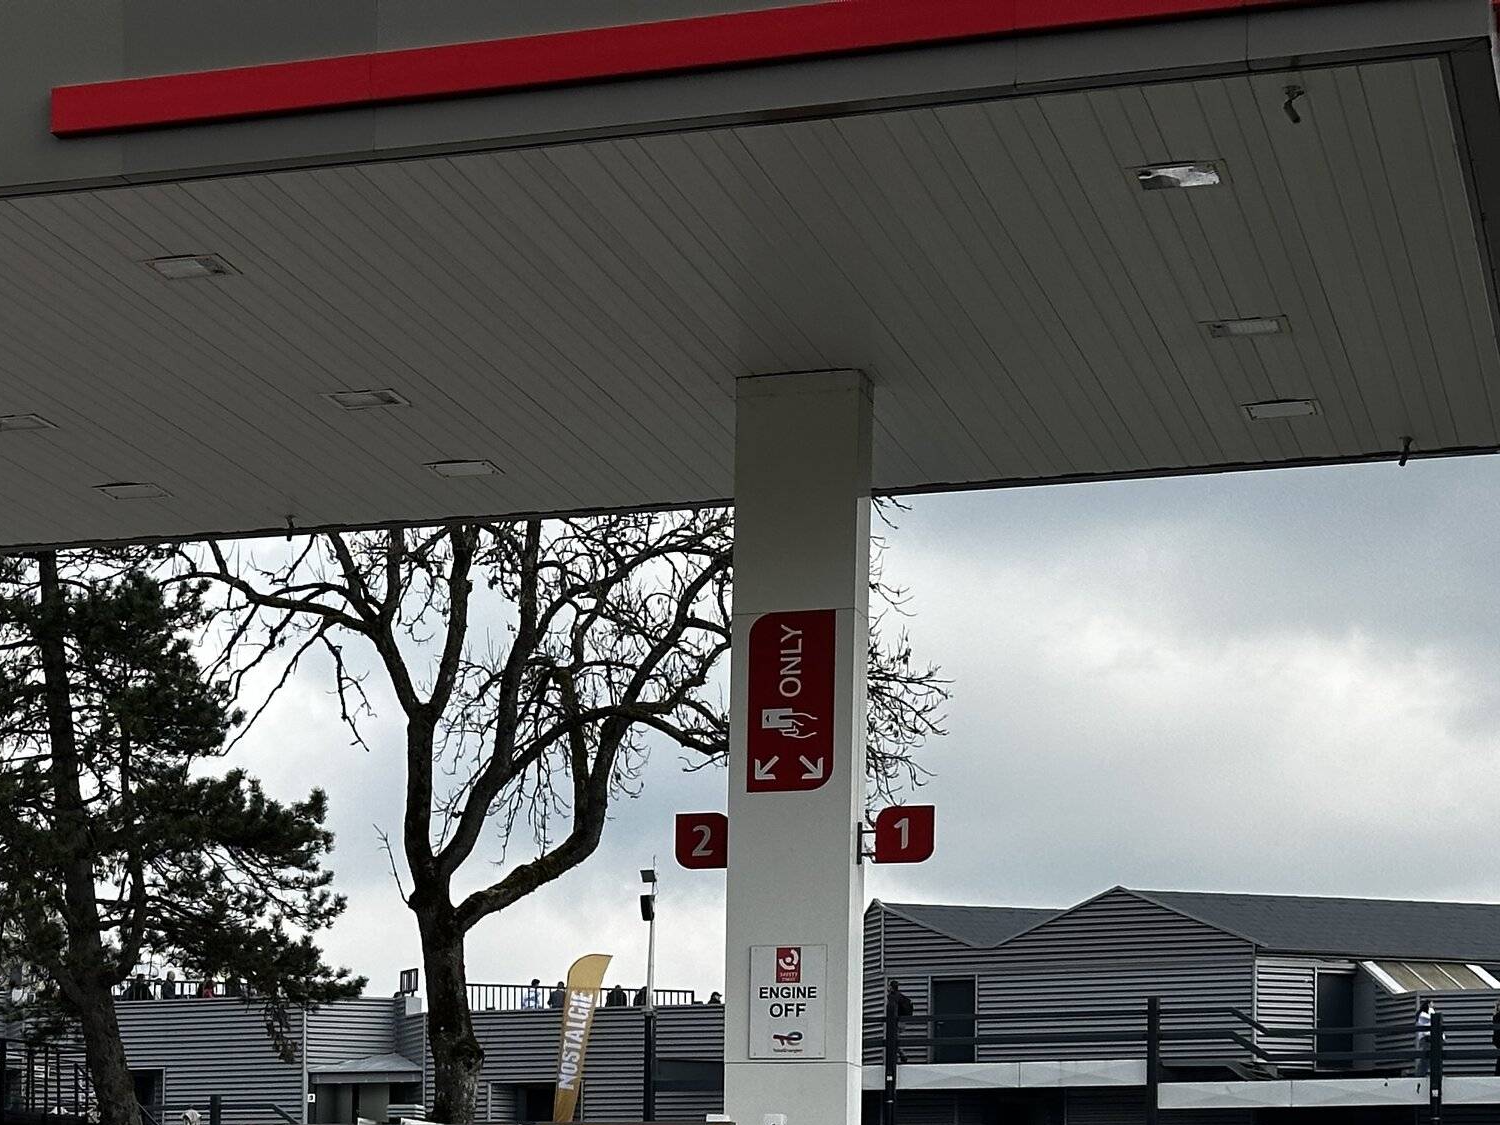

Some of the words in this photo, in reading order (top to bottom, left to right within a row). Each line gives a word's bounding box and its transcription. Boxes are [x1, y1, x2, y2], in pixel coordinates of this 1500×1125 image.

[779, 624, 803, 698] ONLY
[691, 825, 714, 857] 2
[893, 817, 910, 850] 1
[759, 986, 817, 999] ENGINE
[769, 1002, 806, 1018] OFF
[558, 989, 594, 1091] NOSTALGIE
